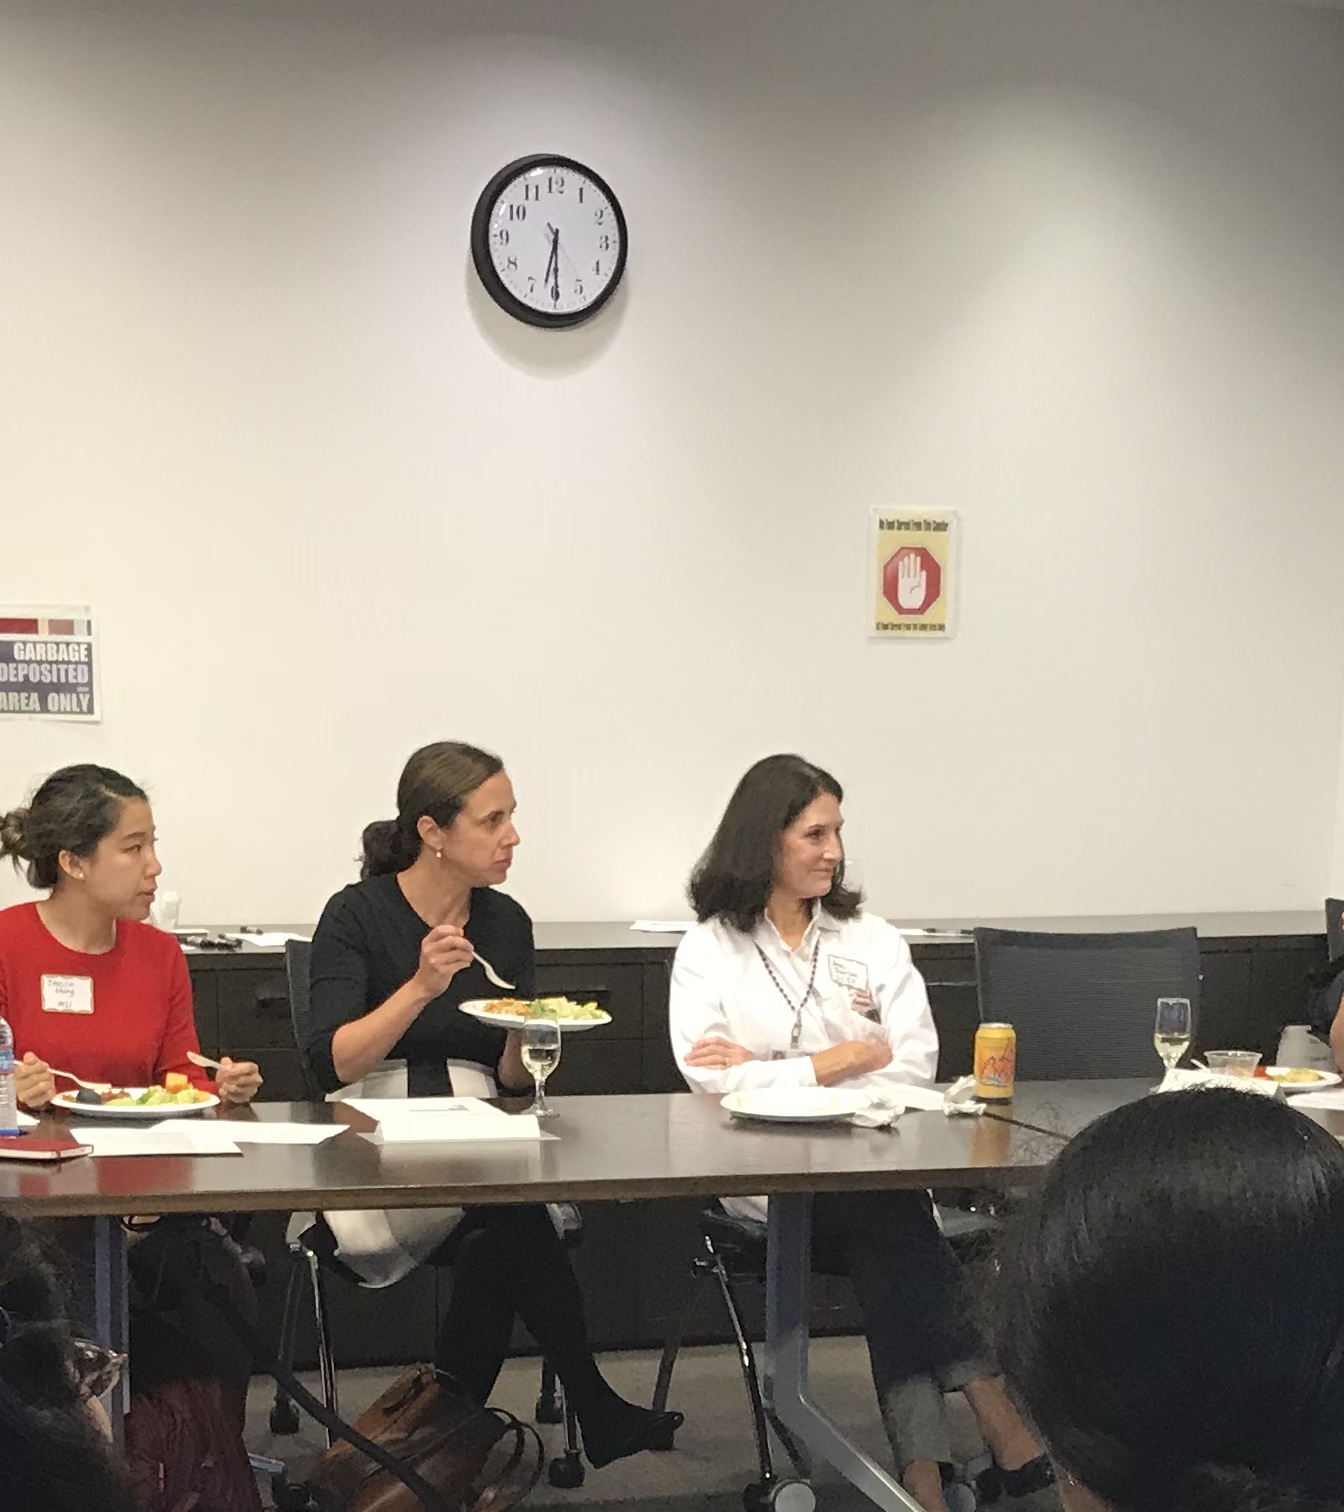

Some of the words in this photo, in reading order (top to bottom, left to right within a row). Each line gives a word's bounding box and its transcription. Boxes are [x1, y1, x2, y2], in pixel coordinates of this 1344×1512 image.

[525, 184, 540, 201] 11
[547, 176, 565, 194] 12
[578, 187, 584, 203] 1
[509, 204, 526, 222] 10
[594, 209, 604, 226] 2
[499, 229, 509, 245] 9
[599, 235, 609, 251] 3
[507, 255, 518, 272] 8
[592, 259, 601, 275] 4
[527, 276, 536, 293] 7
[551, 284, 560, 301] 6
[574, 278, 584, 295] 5
[13, 642, 89, 662] GARBAGE
[47, 692, 90, 712] ONLY
